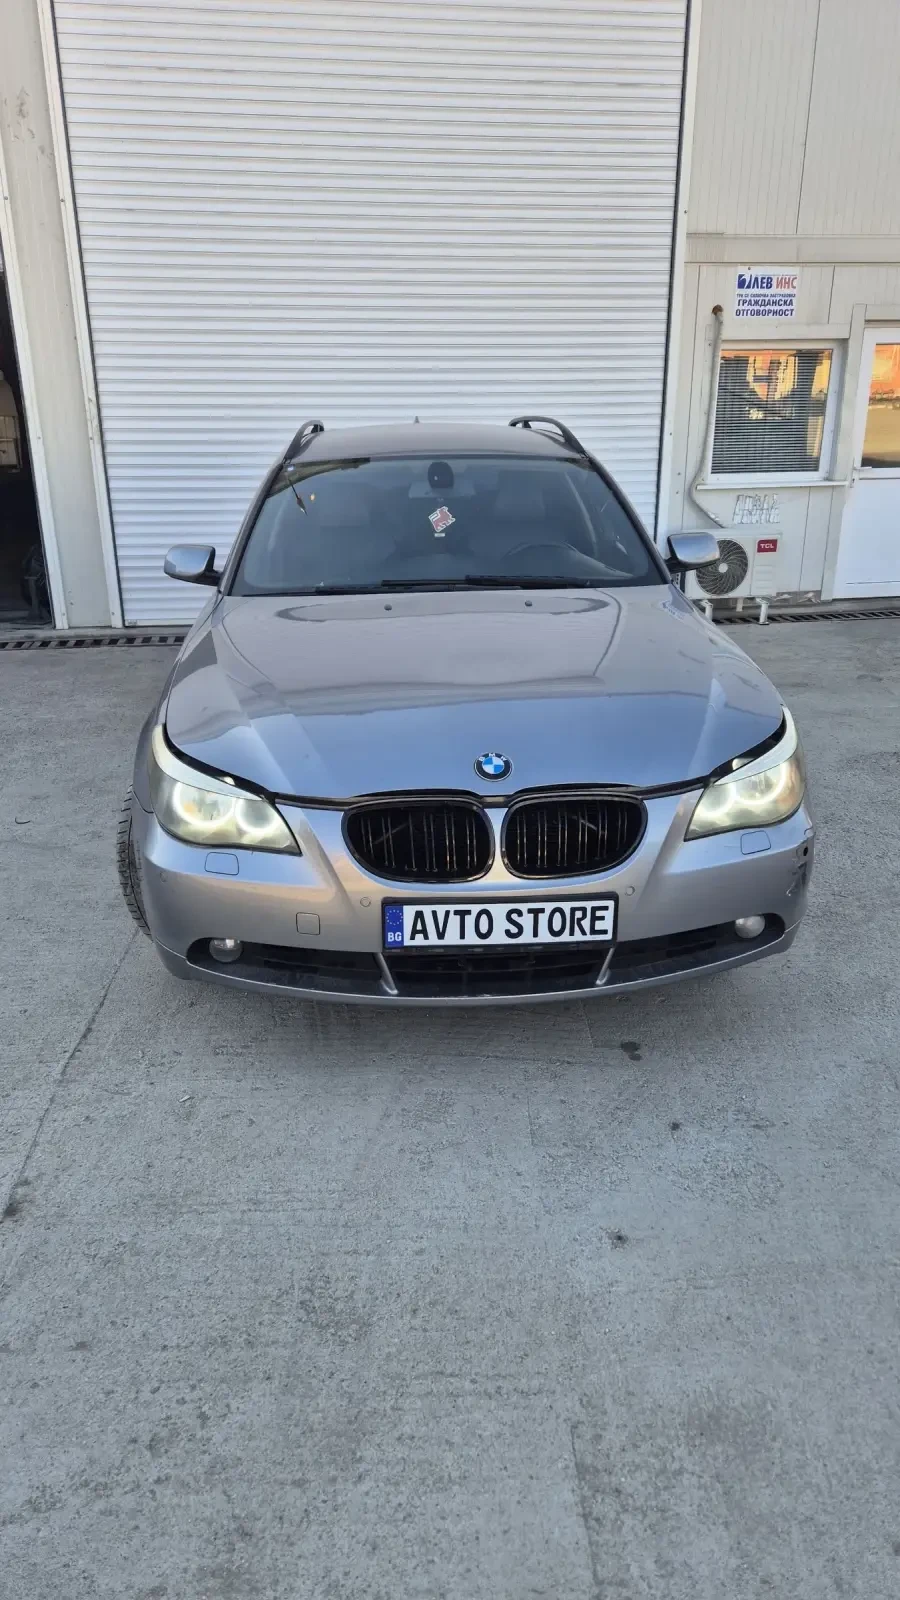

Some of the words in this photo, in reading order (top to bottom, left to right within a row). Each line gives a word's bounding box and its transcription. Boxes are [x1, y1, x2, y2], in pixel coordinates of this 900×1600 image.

[752, 276, 773, 289] ЛЕВ
[776, 276, 797, 289] ИНС
[737, 299, 794, 307] ГРАЖДАНСКА
[735, 308, 794, 316] ОТГОВОРНОСТ
[409, 908, 494, 941] AVTO
[504, 905, 609, 939] STORE
[387, 931, 402, 942] BG
